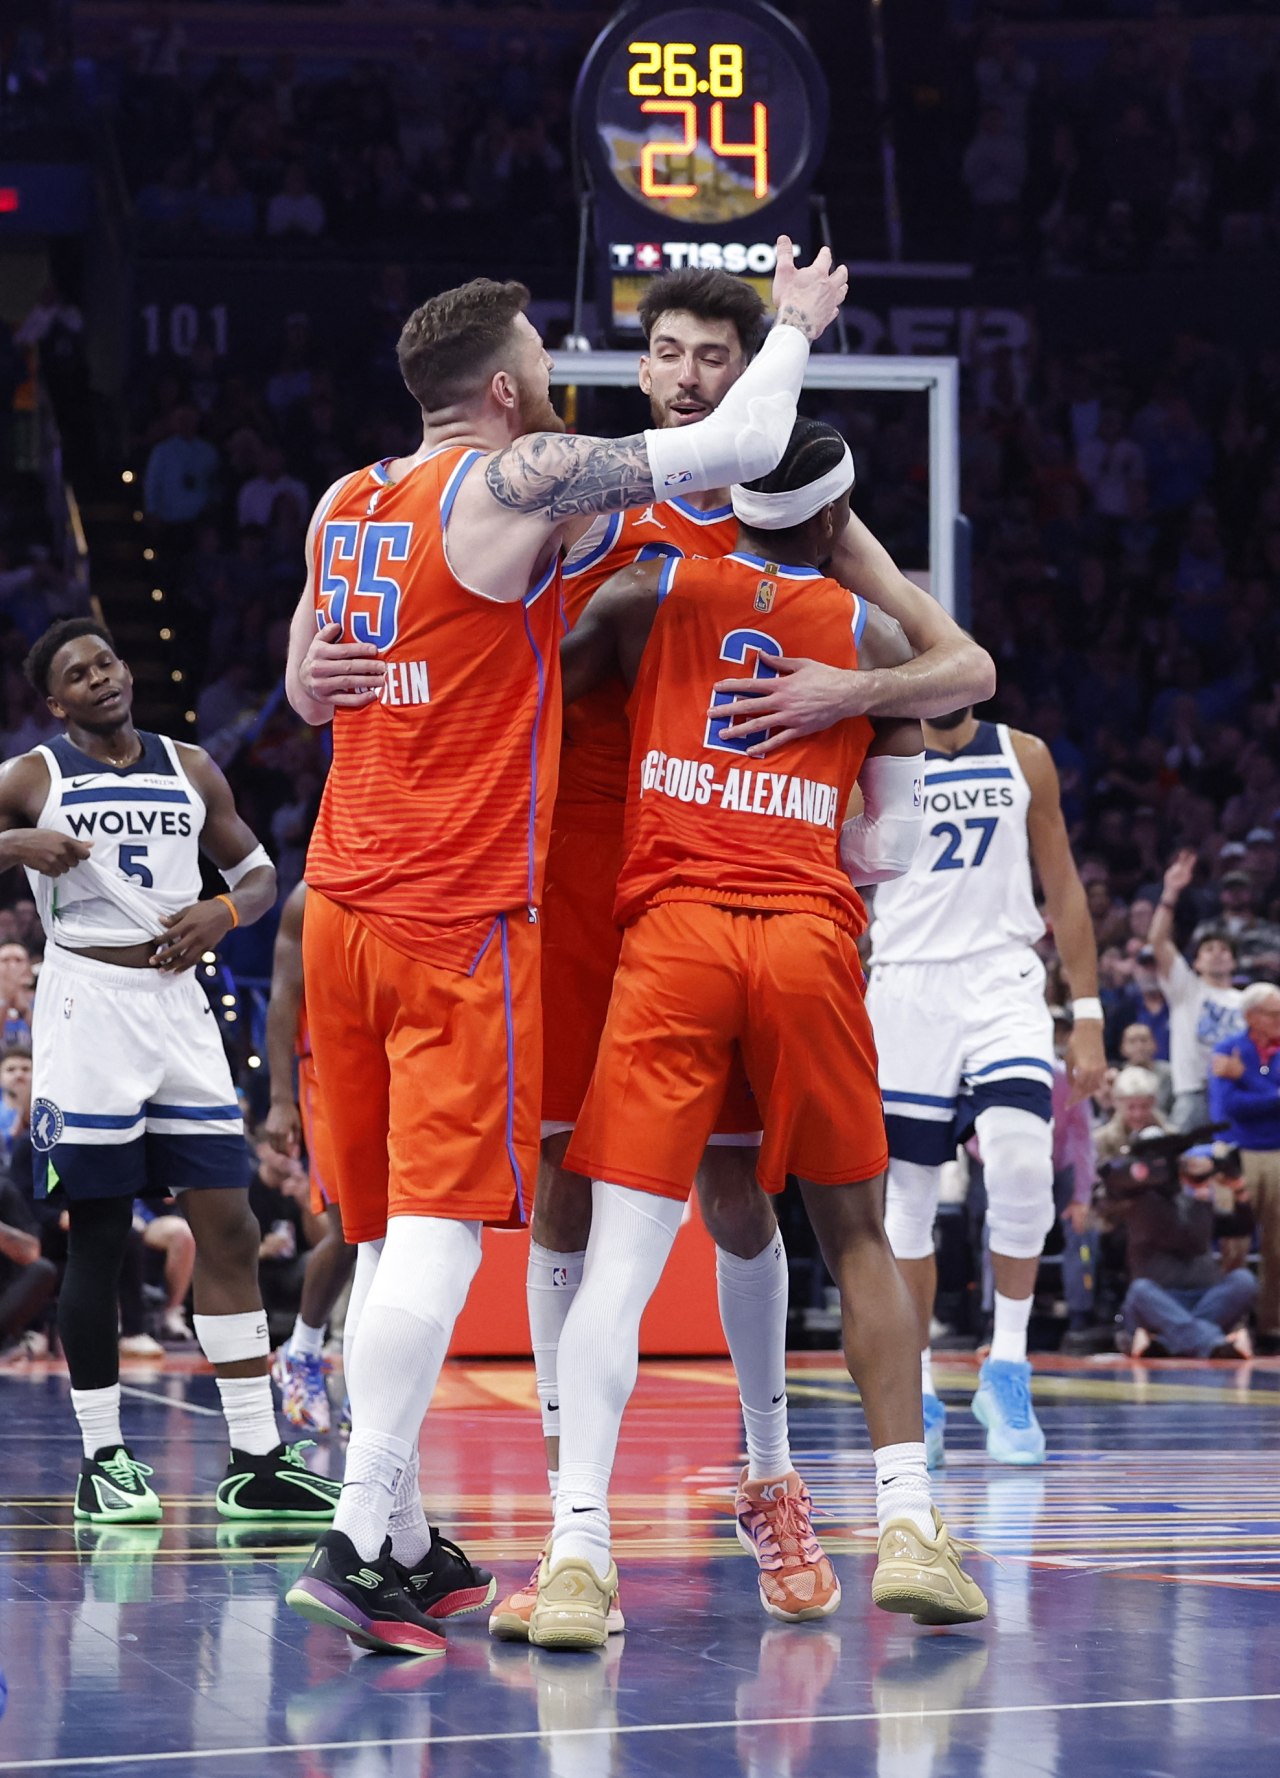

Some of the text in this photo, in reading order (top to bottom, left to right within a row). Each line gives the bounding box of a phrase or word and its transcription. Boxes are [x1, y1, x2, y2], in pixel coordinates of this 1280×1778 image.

[629, 42, 743, 98] 26.8
[640, 100, 768, 199] 24
[662, 243, 801, 273] TISSO
[143, 304, 228, 355] 101
[315, 521, 414, 652] 55
[640, 750, 838, 831] GEOUS-ALEXANDE
[923, 788, 1014, 815] OLVES
[66, 811, 191, 837] WOLVES
[930, 817, 999, 873] 27
[118, 844, 153, 889] 5
